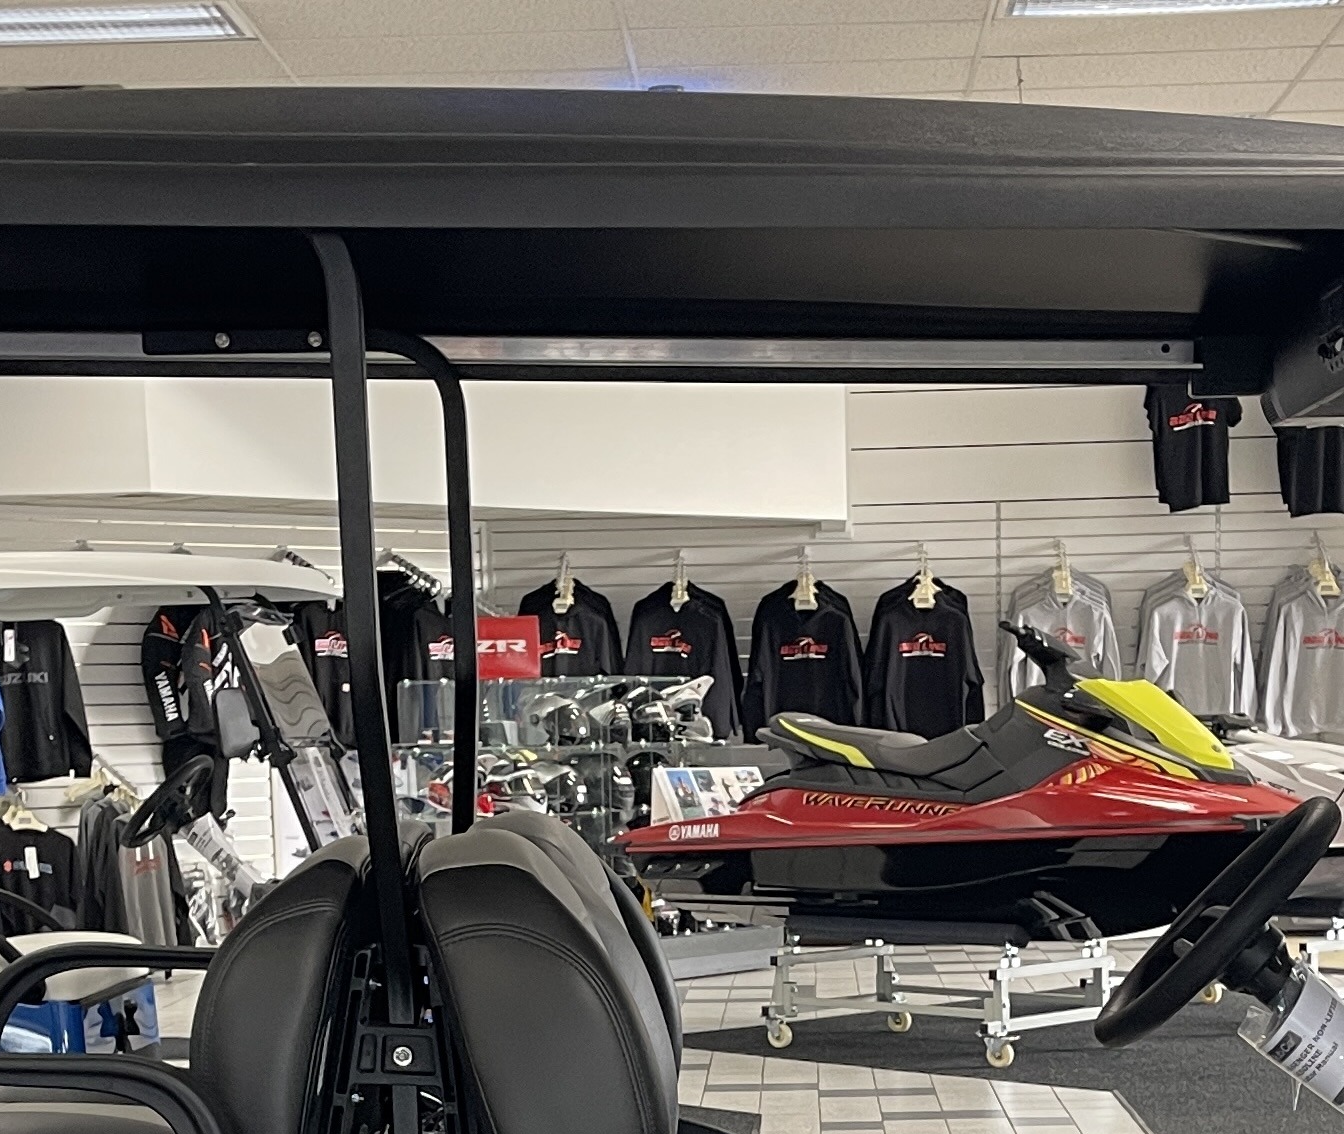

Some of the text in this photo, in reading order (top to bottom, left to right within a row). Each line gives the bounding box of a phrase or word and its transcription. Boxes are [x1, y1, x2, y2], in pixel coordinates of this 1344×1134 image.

[155, 671, 179, 722] YAMAHA
[803, 792, 961, 817] WAVERUNNE
[680, 823, 720, 839] YAMAHA
